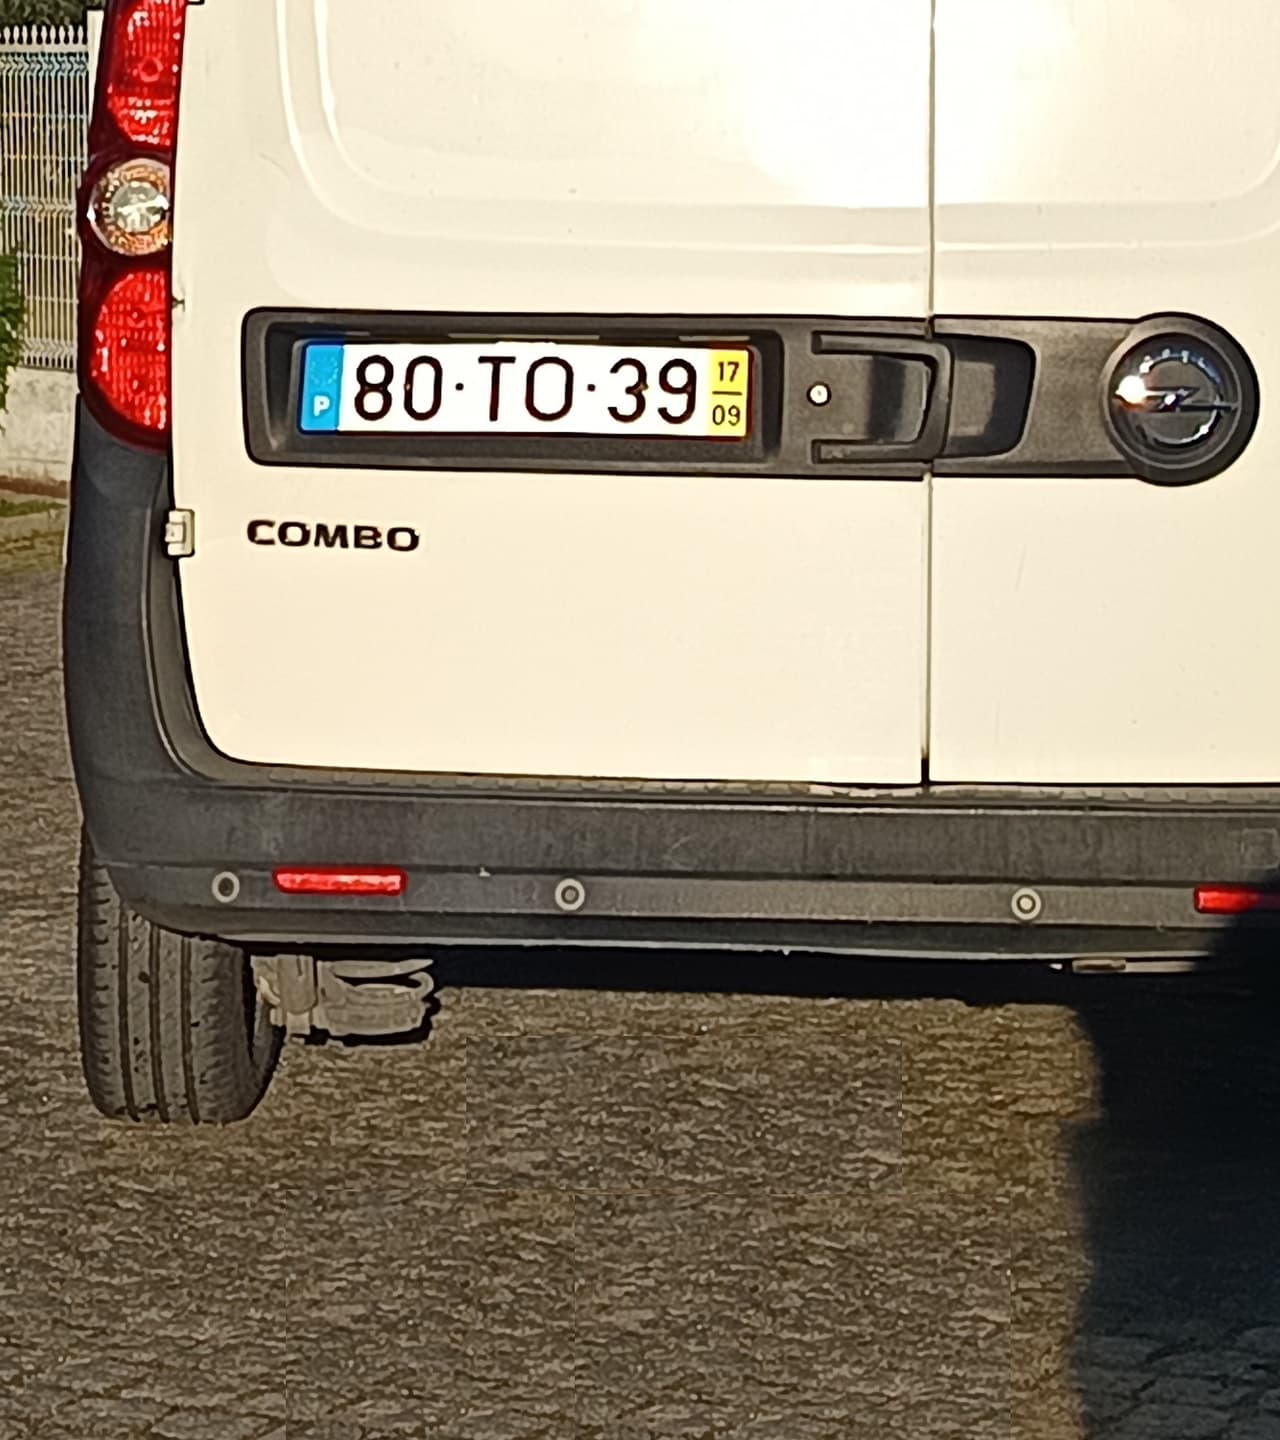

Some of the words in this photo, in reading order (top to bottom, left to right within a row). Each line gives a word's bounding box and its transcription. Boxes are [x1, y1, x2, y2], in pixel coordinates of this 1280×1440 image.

[718, 361, 740, 383] 17
[313, 395, 331, 417] P
[712, 404, 741, 427] 09
[246, 518, 421, 553] COMBO
